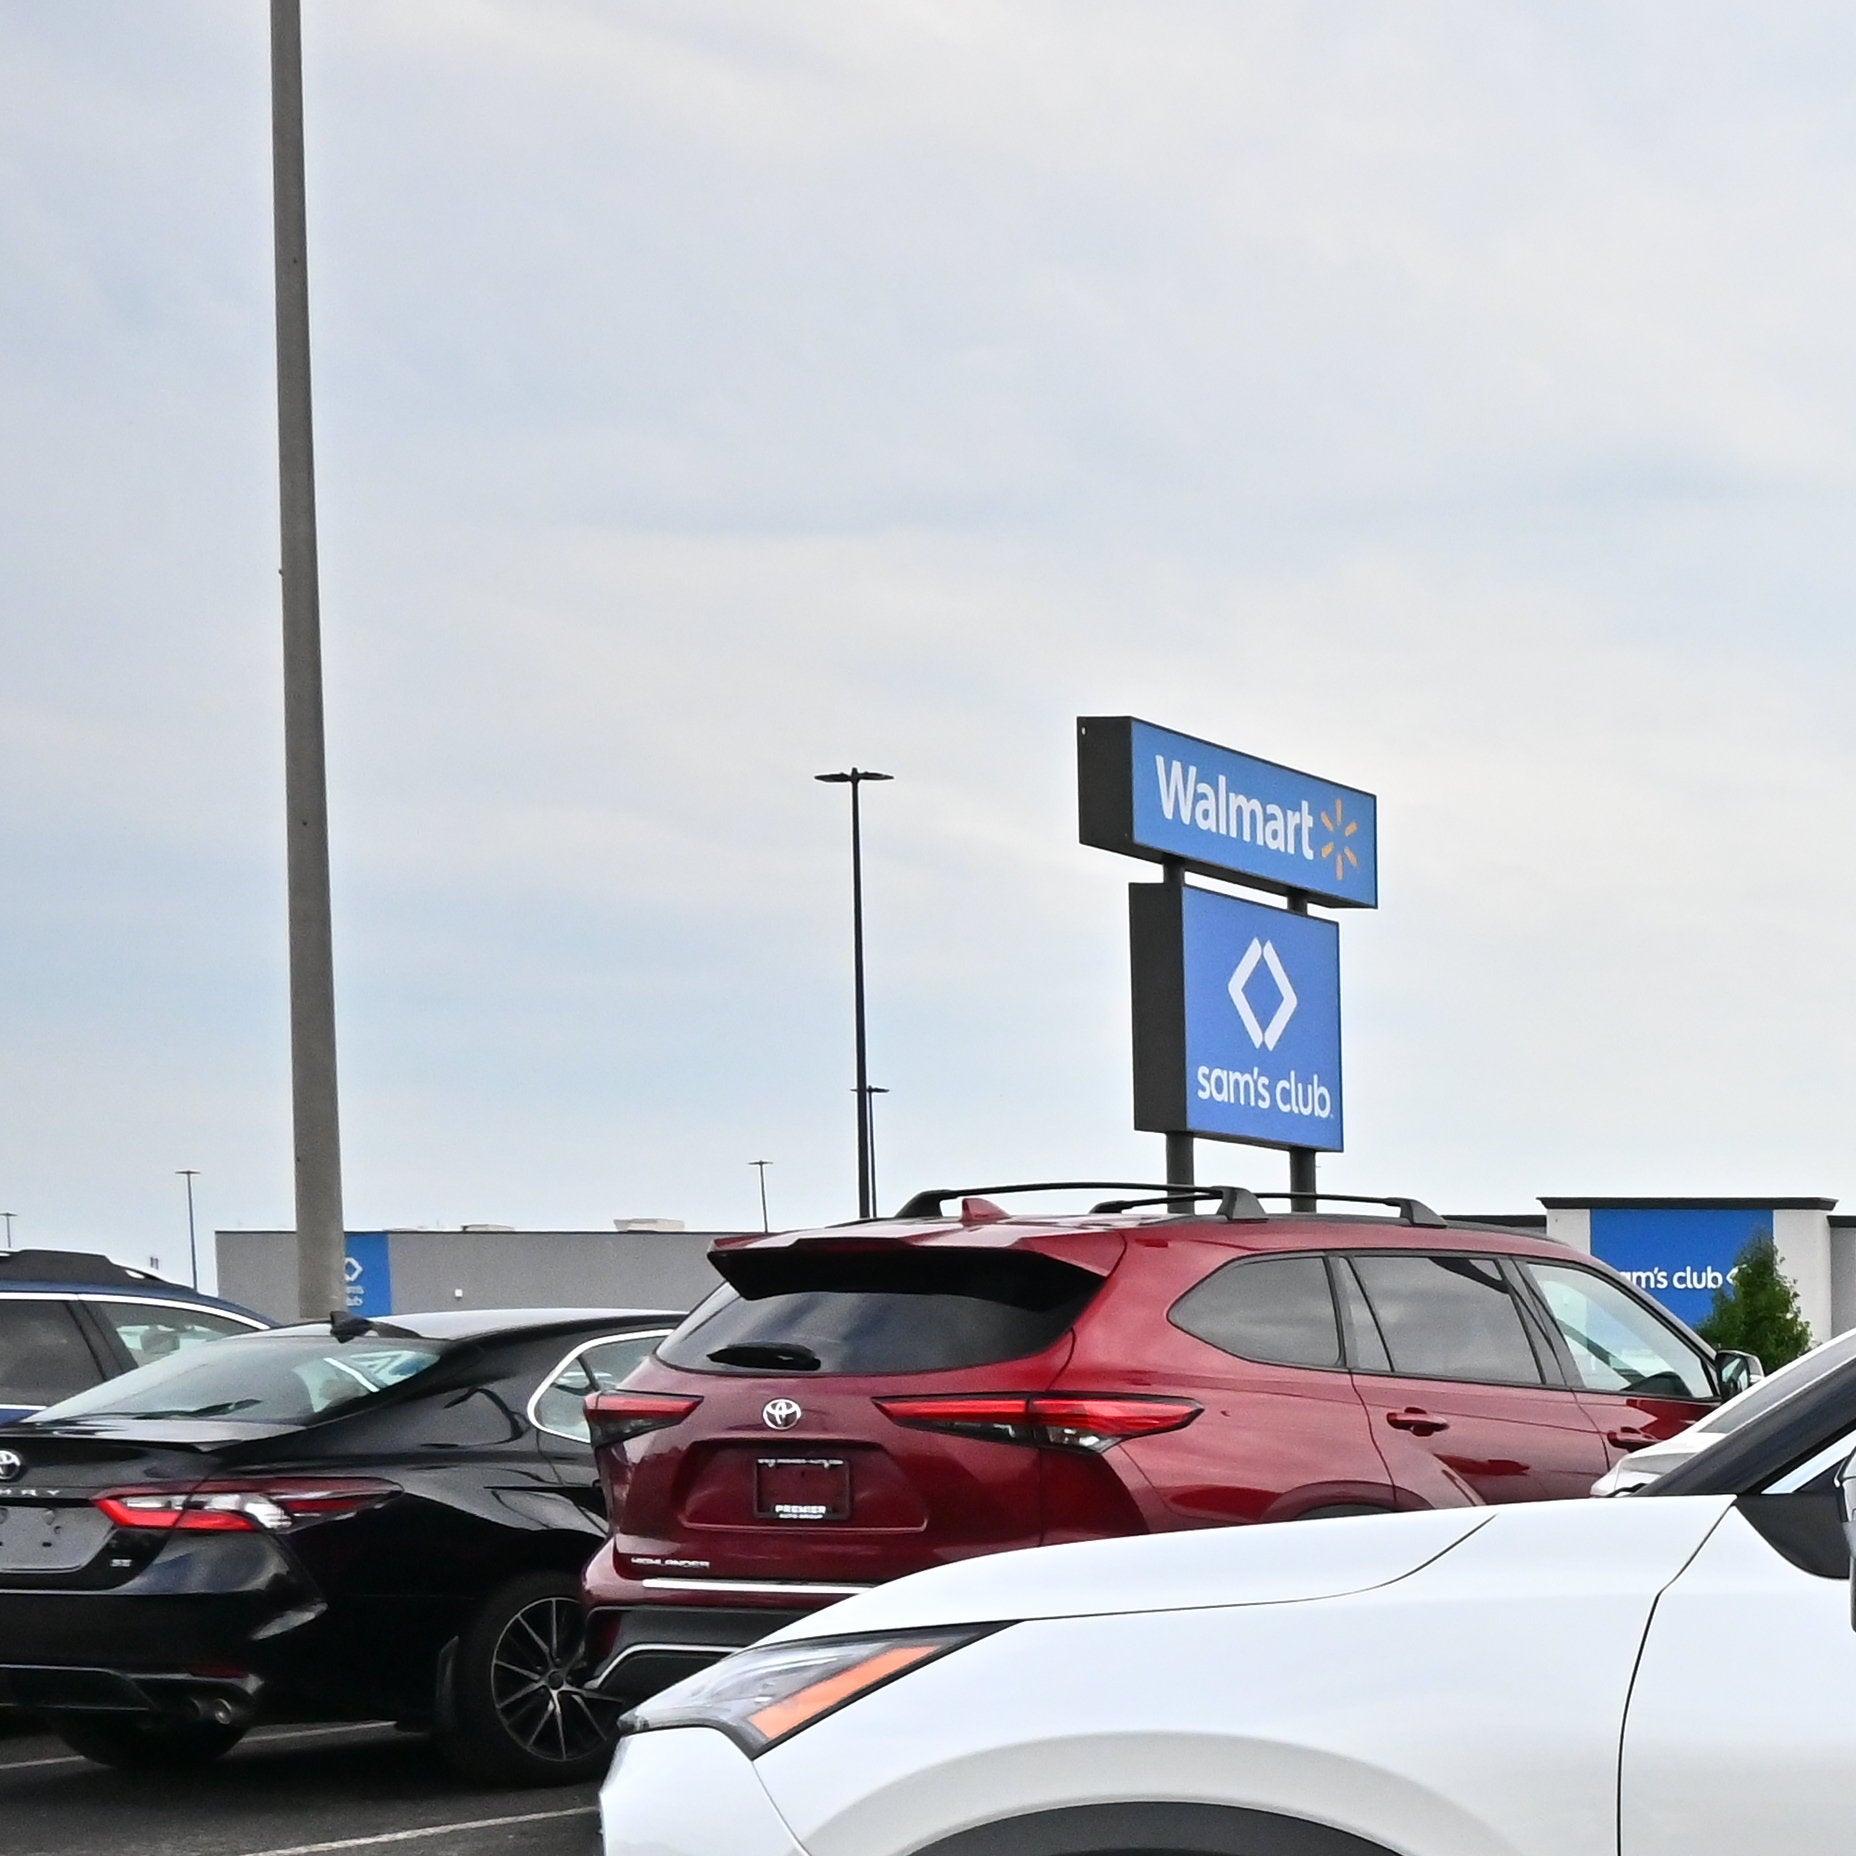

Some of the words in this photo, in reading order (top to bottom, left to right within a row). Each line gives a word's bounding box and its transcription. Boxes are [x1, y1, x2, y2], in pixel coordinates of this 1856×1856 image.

[1155, 755, 1314, 860] Walmart
[1197, 1065, 1270, 1109] sam's
[1275, 1070, 1331, 1118] club
[1620, 1266, 1668, 1289] m's
[1673, 1266, 1722, 1289] club
